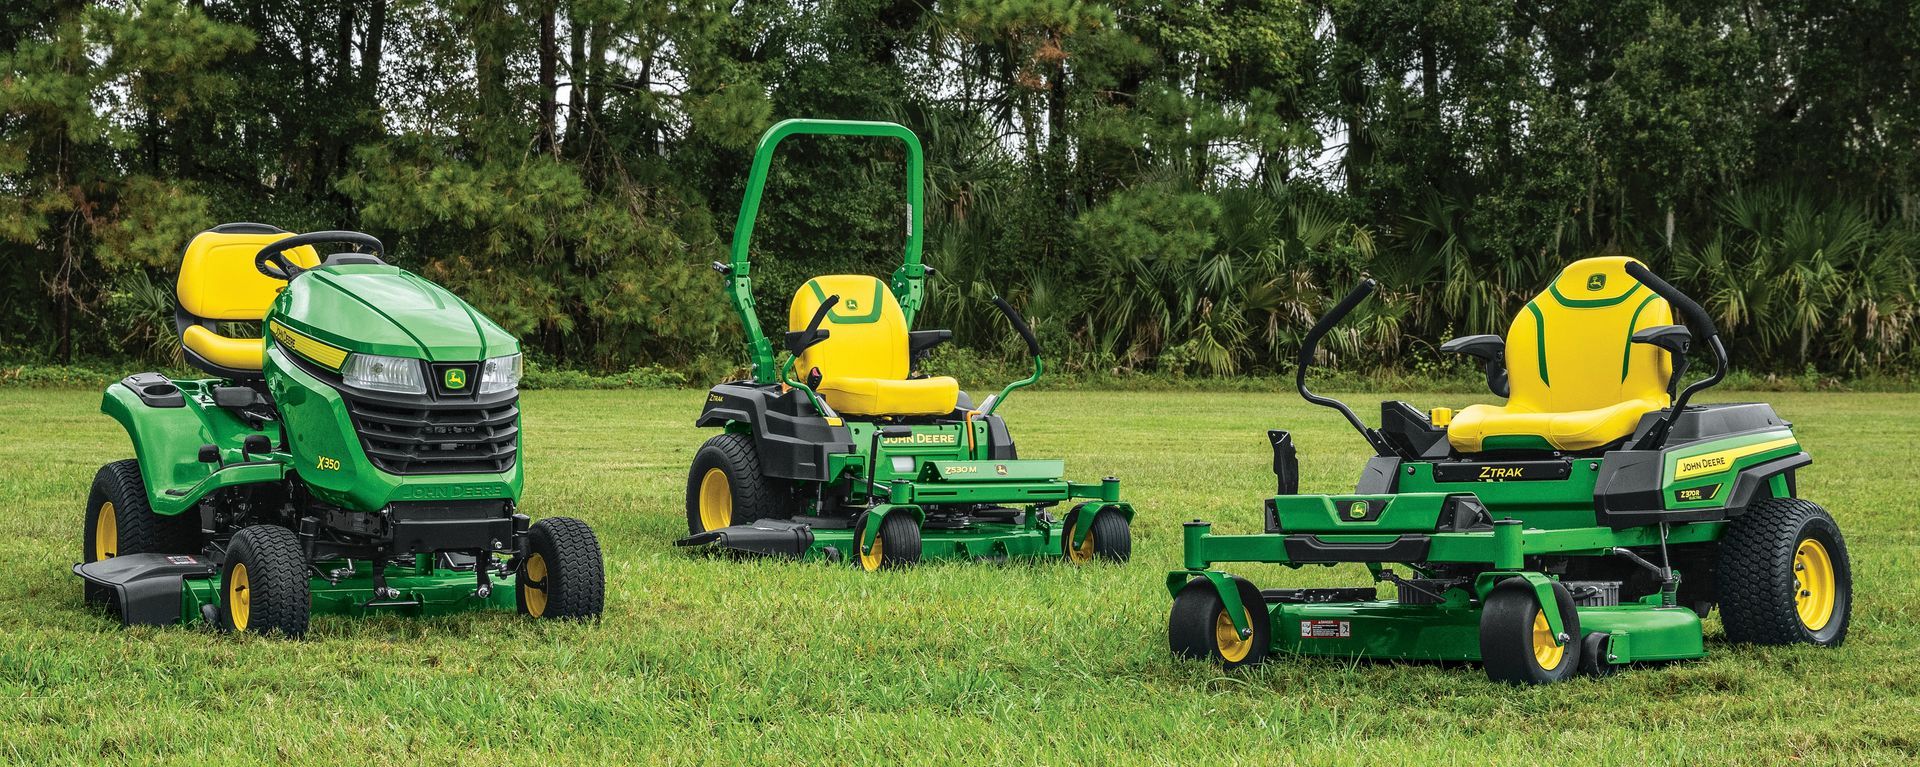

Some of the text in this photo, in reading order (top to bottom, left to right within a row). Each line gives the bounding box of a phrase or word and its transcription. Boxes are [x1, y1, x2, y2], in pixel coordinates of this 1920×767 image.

[883, 433, 955, 444] JOHN DEERE
[316, 455, 341, 471] X350
[1682, 457, 1726, 472] JOHN DEERE
[1479, 466, 1524, 478] ZTRAK
[402, 486, 502, 498] JOHN DEERE
[1680, 489, 1701, 499] Z370R
